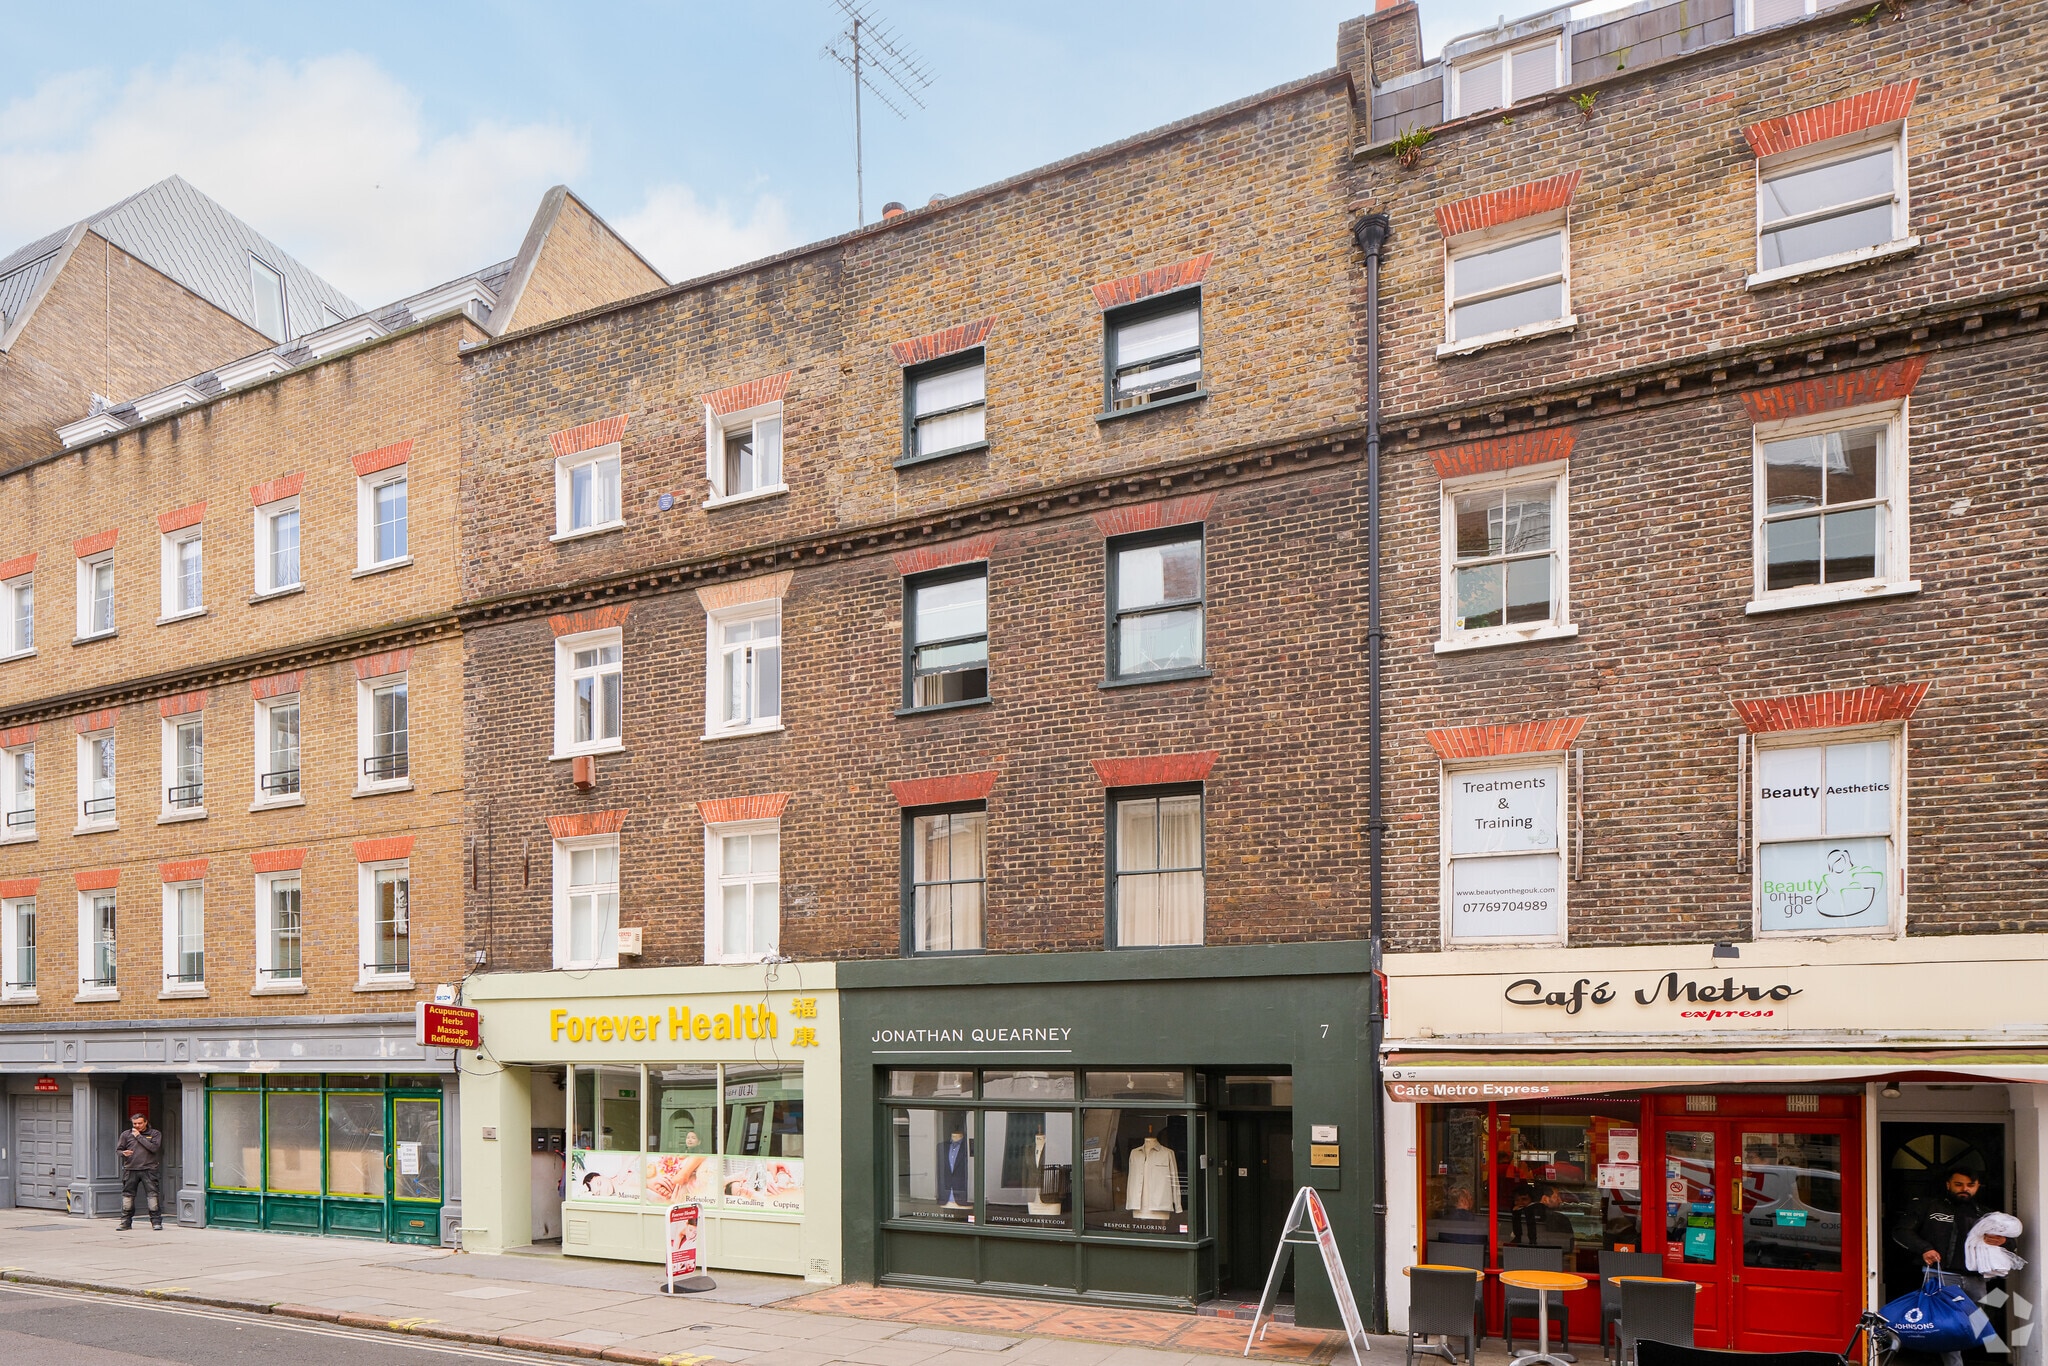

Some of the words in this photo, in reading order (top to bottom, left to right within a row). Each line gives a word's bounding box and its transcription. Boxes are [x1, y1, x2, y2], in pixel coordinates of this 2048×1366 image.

[1462, 777, 1546, 793] Treatments
[1761, 785, 1820, 799] Beauty
[1826, 782, 1890, 795] Aesthetics
[1497, 797, 1509, 809] &
[1475, 816, 1533, 829] Training
[1456, 887, 1555, 896] www.beautyonthegouk.com
[1763, 879, 1823, 895] Beauty
[1769, 892, 1786, 902] on
[1788, 892, 1813, 906] the
[1463, 900, 1547, 913] 07769704989
[1784, 904, 1803, 918] go
[1504, 978, 1617, 1015] Café
[1634, 972, 1804, 1005] Metro
[429, 1005, 475, 1018] Acupuncture
[1680, 1009, 1774, 1022] express
[442, 1016, 464, 1026] Herbs
[550, 1007, 661, 1043] Forever
[667, 1003, 778, 1041] Health
[437, 1025, 469, 1037] Massage
[871, 1029, 963, 1043] JONATHAN
[971, 1027, 1072, 1043] QUEARNEY
[1320, 1024, 1329, 1039] 7
[431, 1034, 474, 1047] Reflexology
[1394, 1083, 1429, 1096] Cafe
[1433, 1083, 1479, 1096] Metro
[1483, 1083, 1550, 1097] Express
[618, 1191, 641, 1200] Massage
[725, 1197, 737, 1205] Ear
[737, 1198, 764, 1207] Candling
[773, 1200, 800, 1209] Cupping
[991, 1215, 1066, 1225] JONATHANQUEARNEY.COM
[1132, 1223, 1167, 1231] TAILORING
[1894, 1322, 1935, 1330] JOHNSONS
